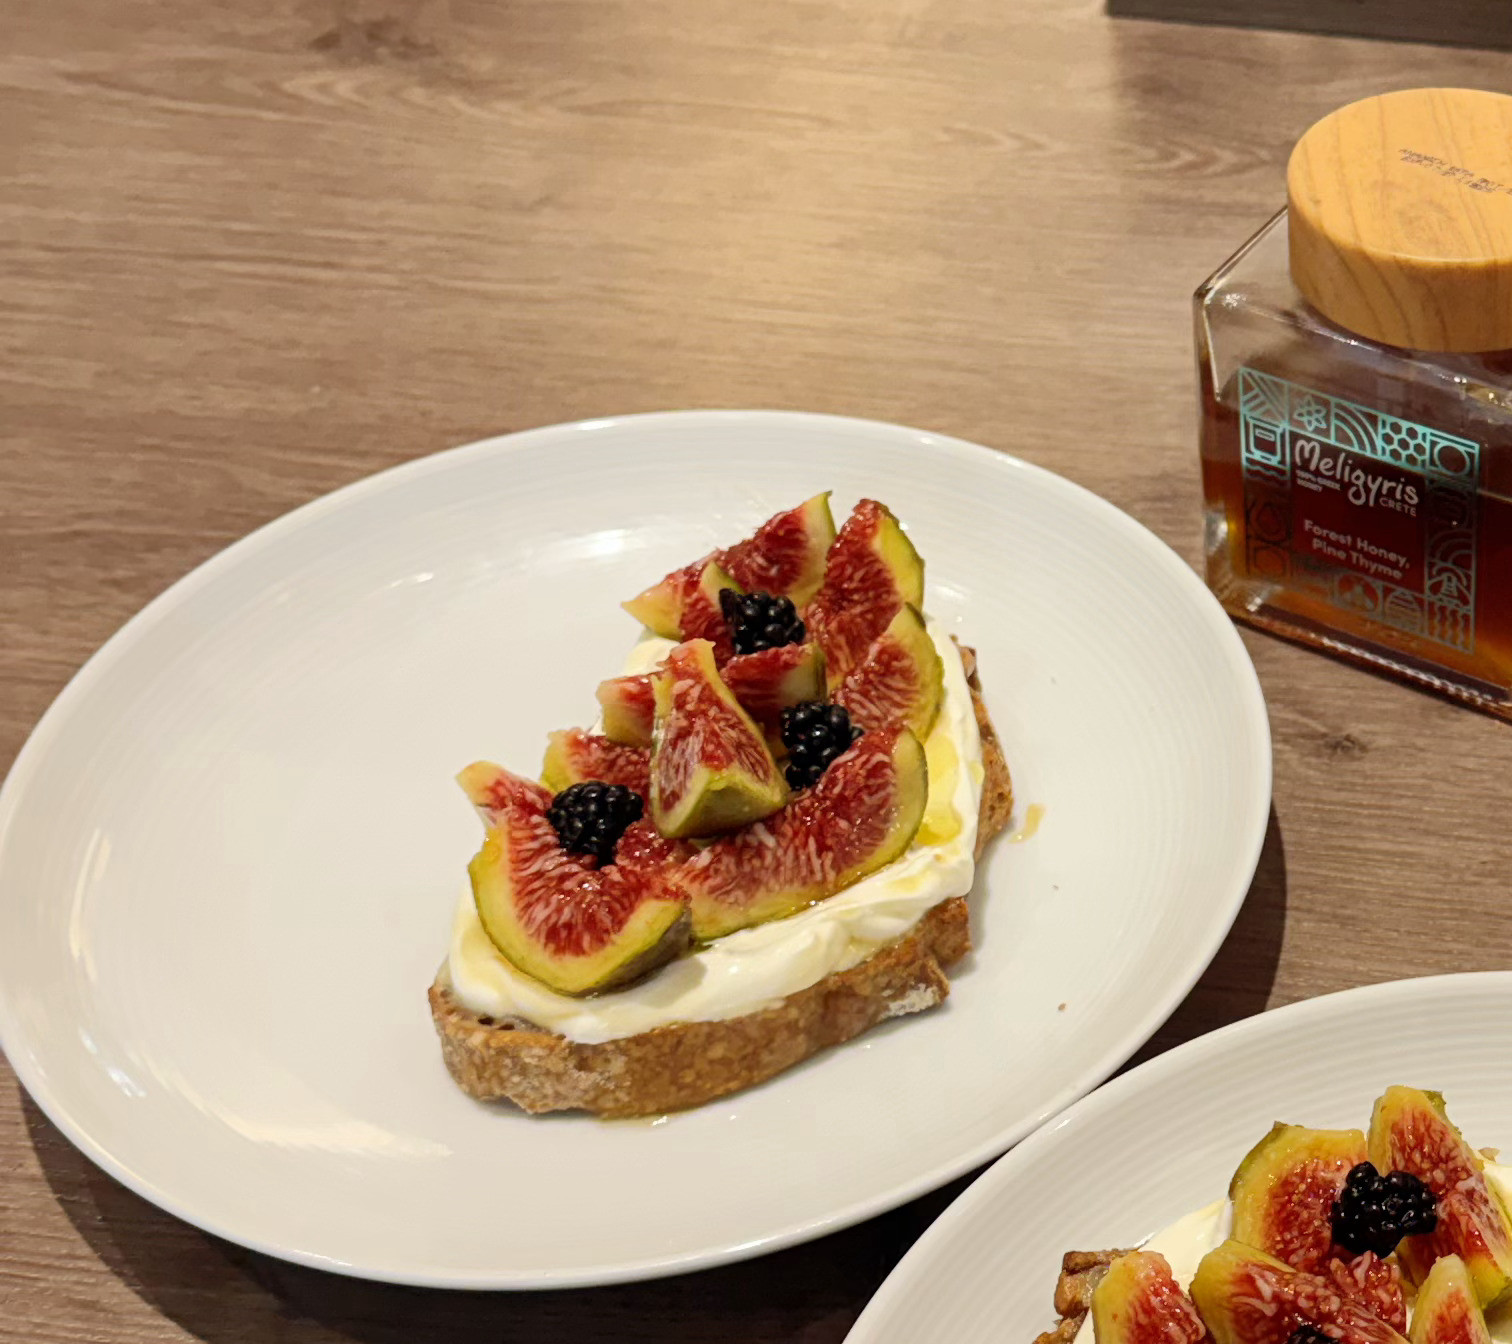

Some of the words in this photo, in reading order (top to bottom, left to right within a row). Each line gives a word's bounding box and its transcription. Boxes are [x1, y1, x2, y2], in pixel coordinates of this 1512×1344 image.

[1294, 439, 1419, 507] Meligyris
[1379, 497, 1417, 517] CRETE
[1304, 519, 1353, 546] Forest
[1356, 537, 1410, 569] Honey,
[1312, 538, 1347, 561] Pine
[1349, 550, 1402, 579] Thyme
